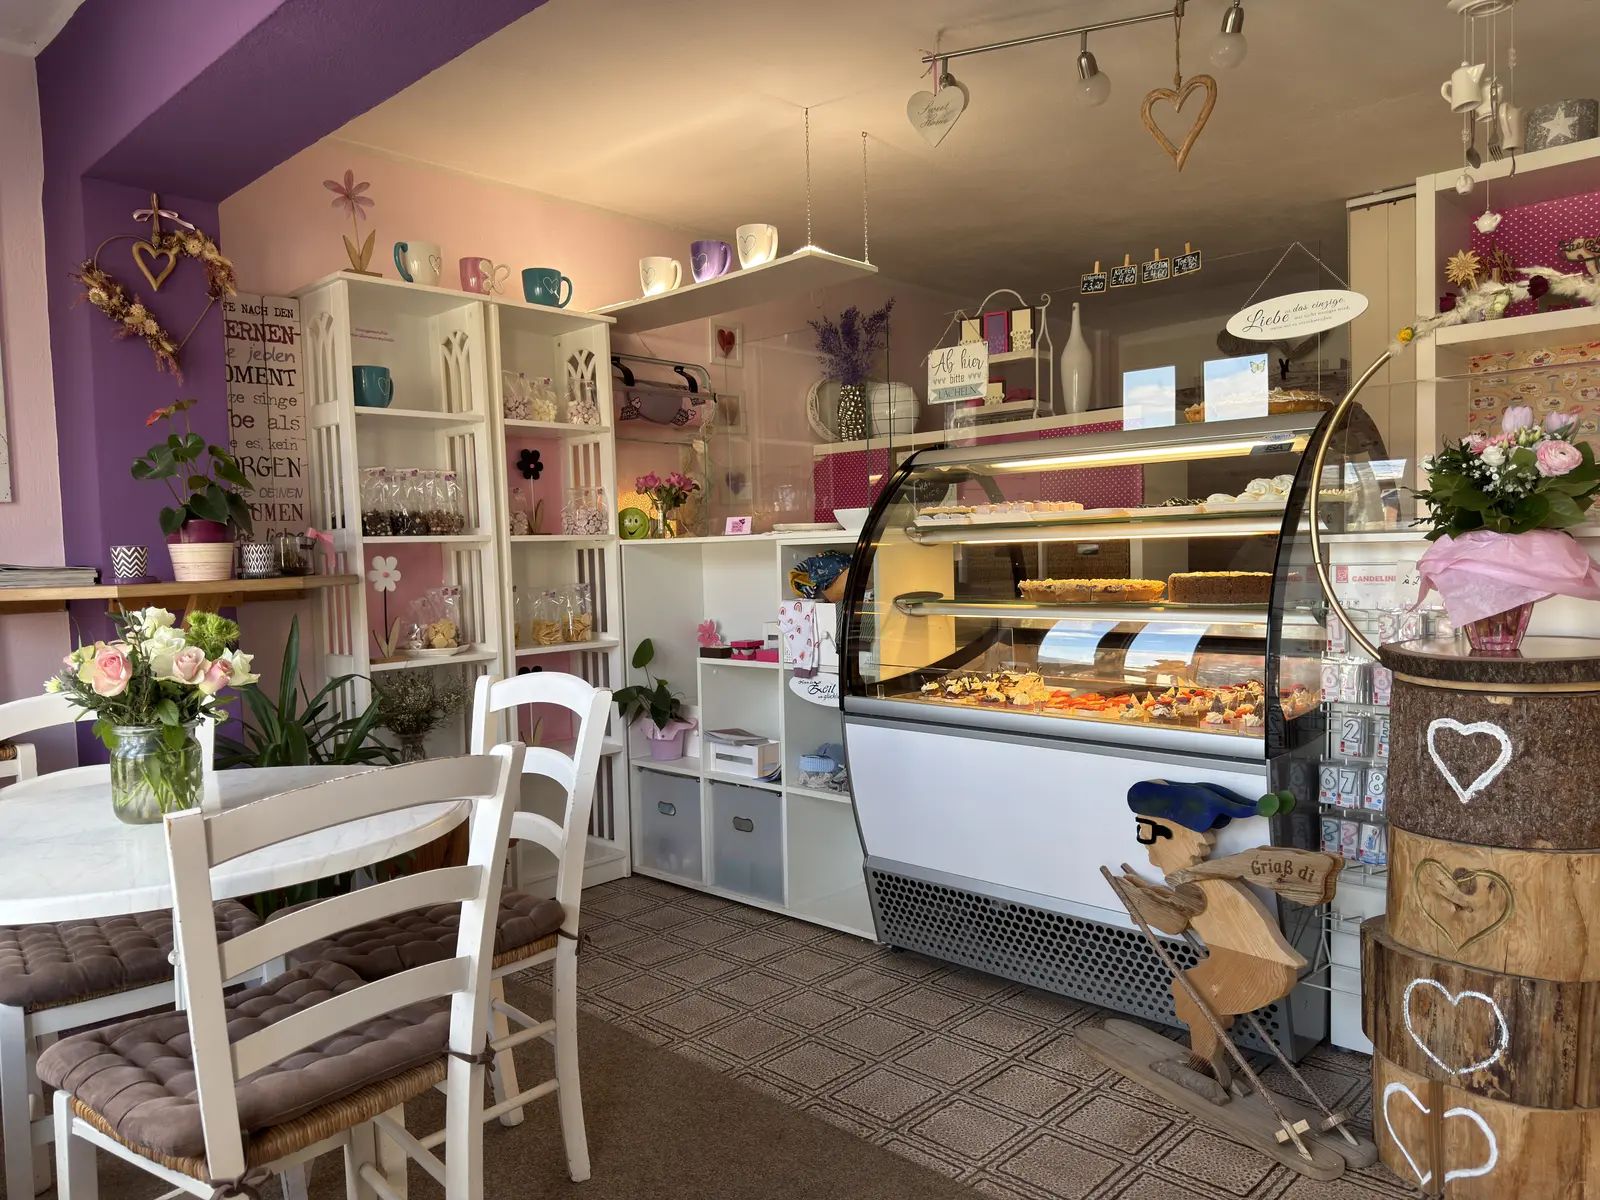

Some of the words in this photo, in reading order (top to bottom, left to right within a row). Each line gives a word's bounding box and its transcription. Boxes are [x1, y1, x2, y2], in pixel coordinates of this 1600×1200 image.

[241, 304, 268, 316] NACH
[274, 307, 294, 318] DEN
[1242, 309, 1290, 333] Liebe
[1292, 303, 1308, 313] das
[247, 343, 295, 363] jeden
[932, 348, 954, 376] Ab
[960, 348, 984, 370] hier
[949, 374, 964, 384] bitte
[253, 392, 297, 410] singe
[267, 414, 300, 431] als
[268, 439, 298, 451] kein
[1341, 719, 1361, 744] 2
[1321, 768, 1337, 791] 6
[1341, 770, 1358, 795] 7
[1369, 772, 1386, 796] 8
[1251, 859, 1294, 878] Griaß
[1298, 865, 1316, 883] di
